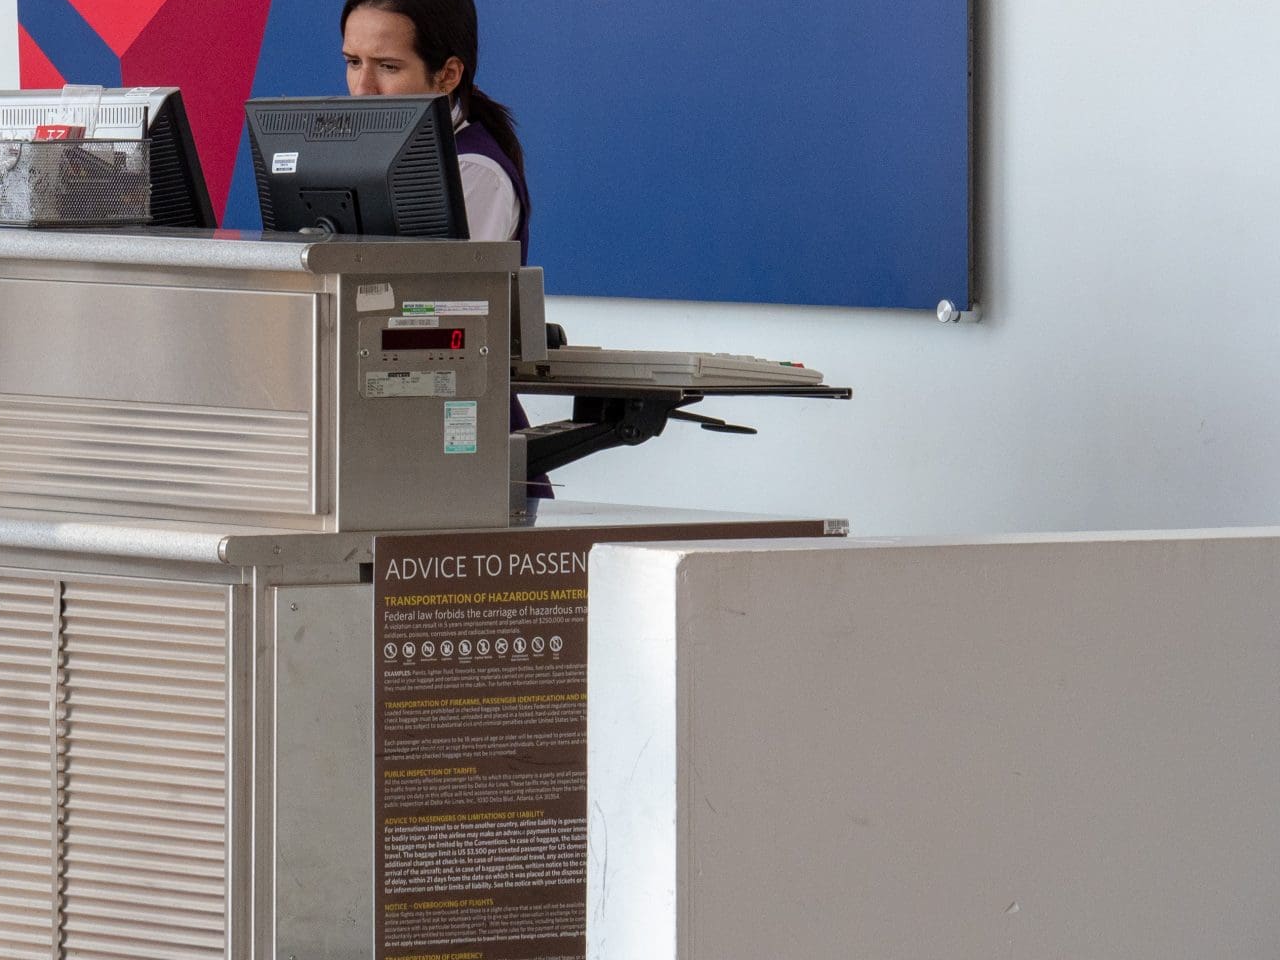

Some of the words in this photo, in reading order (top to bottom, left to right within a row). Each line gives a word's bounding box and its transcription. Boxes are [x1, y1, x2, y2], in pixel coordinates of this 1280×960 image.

[450, 329, 463, 349] 0
[385, 555, 467, 581] ADVICE
[473, 553, 503, 578] TO
[509, 551, 586, 576] PASSEN
[384, 593, 472, 607] TRANSPORTATION
[473, 592, 486, 603] OF
[488, 590, 549, 602] HAZARDOUS
[384, 611, 415, 622] Federal
[417, 610, 432, 621] law
[435, 608, 465, 619] forbids
[467, 608, 481, 619] the
[483, 607, 517, 619] carriage
[519, 606, 528, 617] of
[529, 604, 573, 616] hazardous
